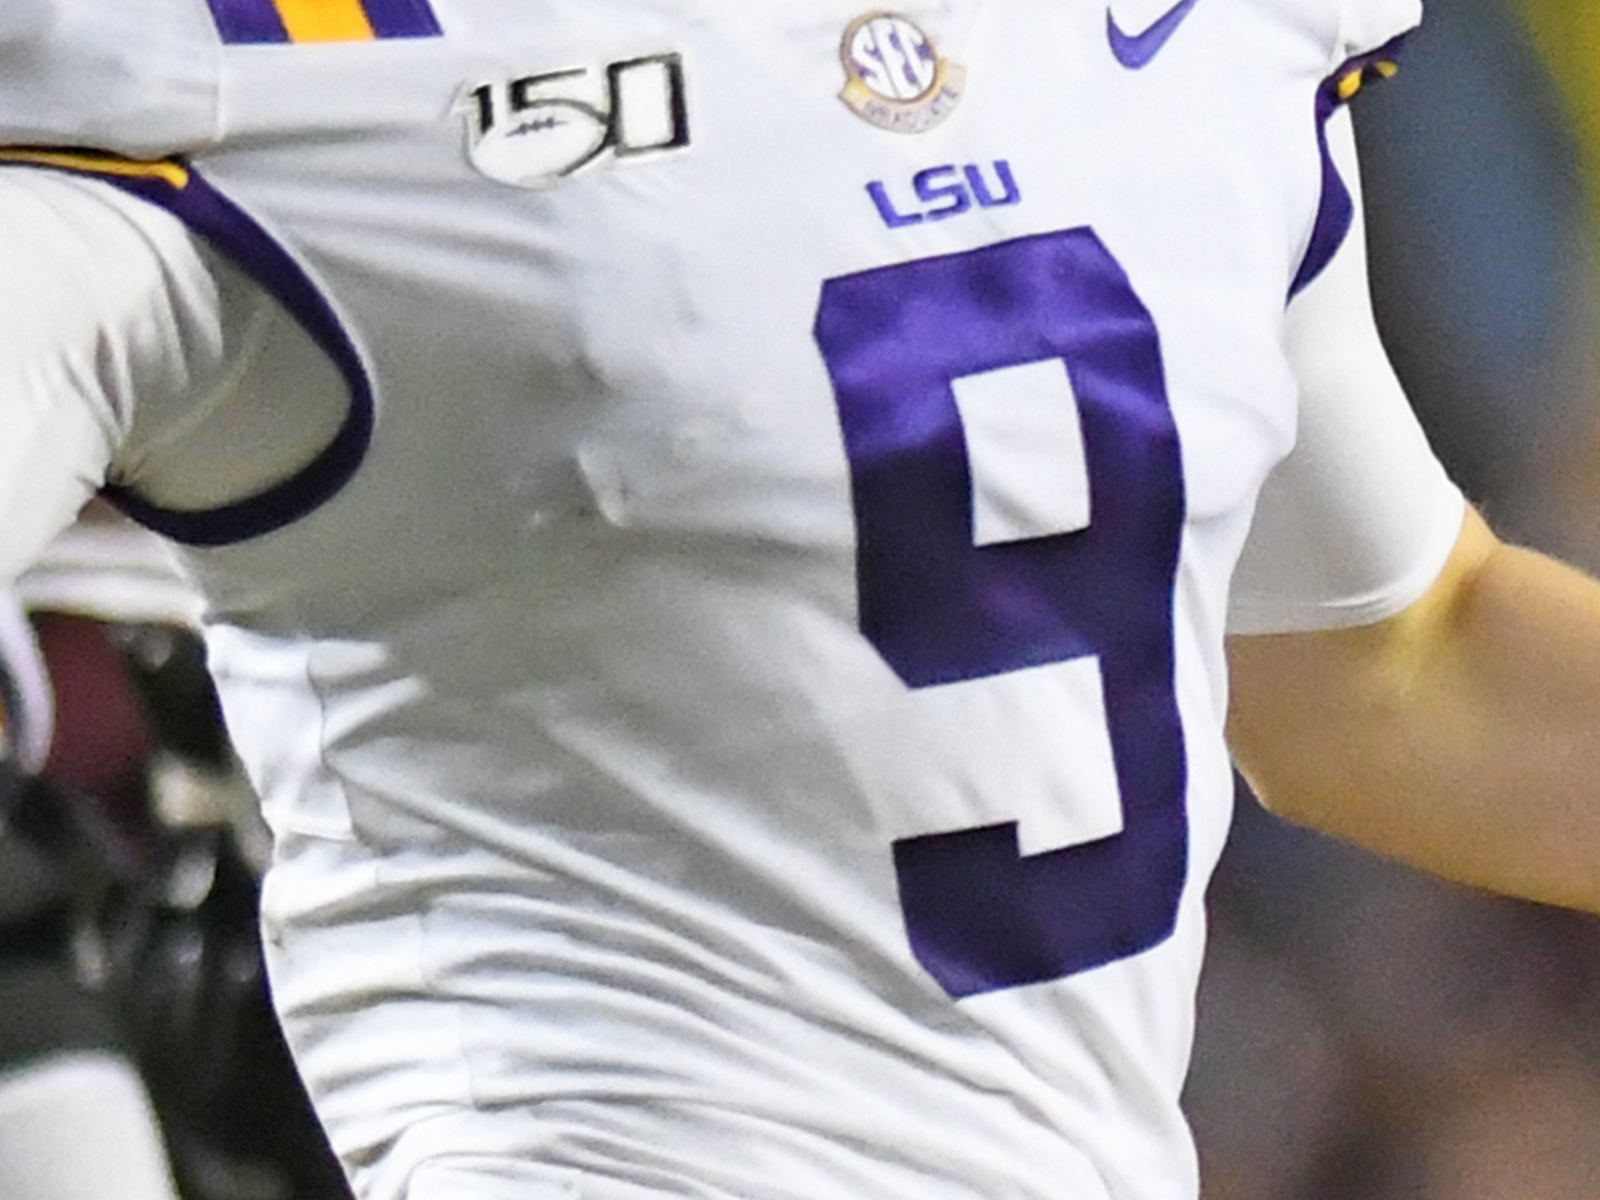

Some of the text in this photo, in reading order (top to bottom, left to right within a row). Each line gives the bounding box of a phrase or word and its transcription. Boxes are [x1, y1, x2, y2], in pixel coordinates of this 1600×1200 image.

[851, 16, 937, 100] SEC
[469, 51, 691, 178] 150
[865, 159, 1021, 229] LSU
[812, 224, 1188, 1000] 9
